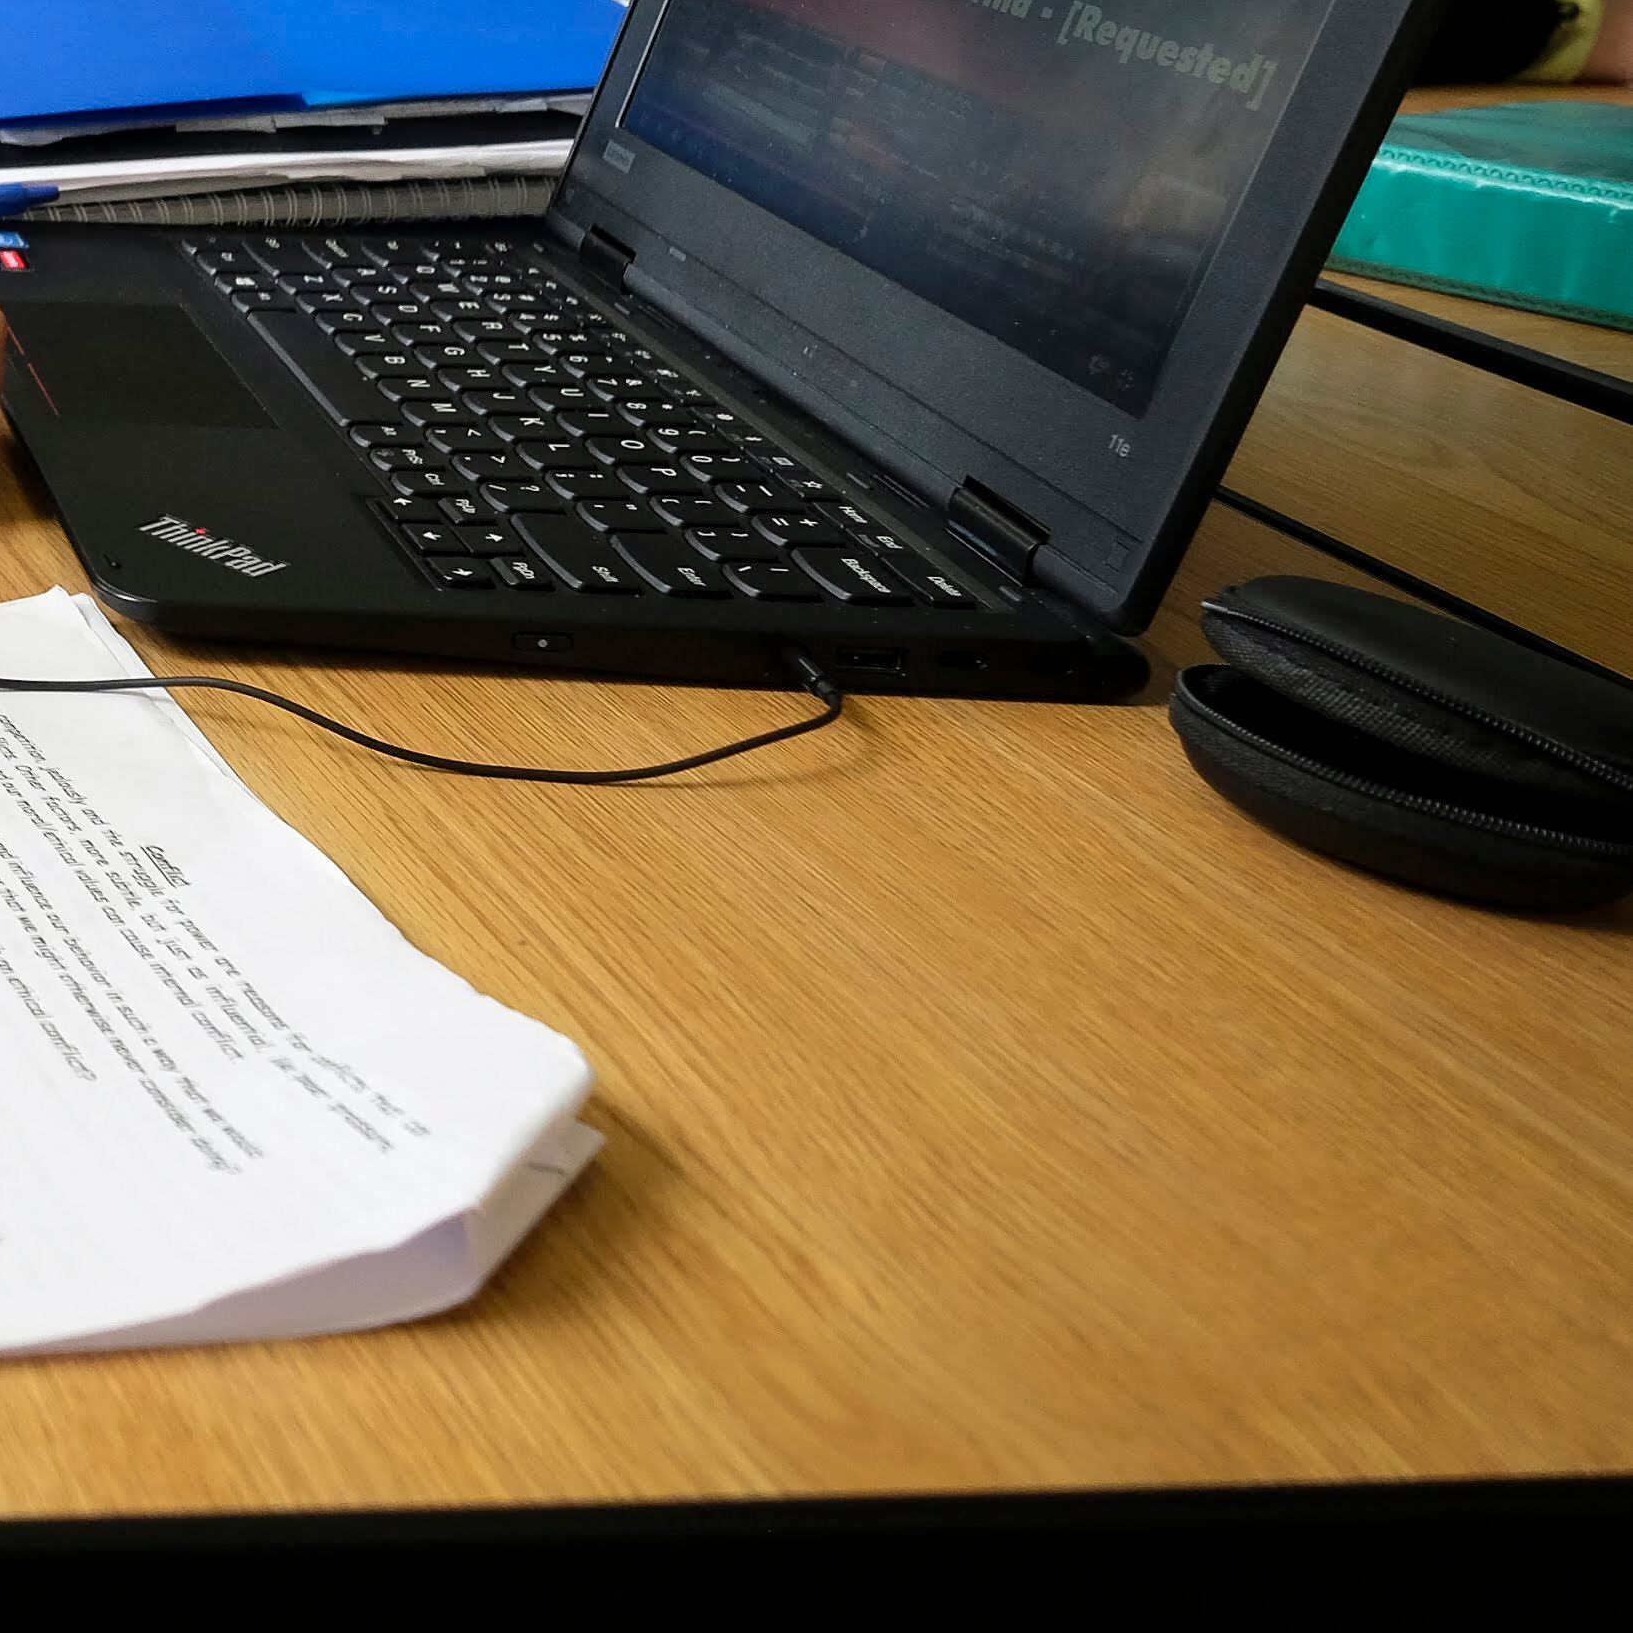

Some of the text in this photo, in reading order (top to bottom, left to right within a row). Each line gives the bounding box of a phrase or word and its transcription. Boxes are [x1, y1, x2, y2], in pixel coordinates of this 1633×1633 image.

[1056, 0, 1277, 112] [Requested]
[467, 369, 490, 378] H
[534, 365, 556, 375] Y
[560, 388, 584, 397] U
[519, 417, 545, 426] K
[1108, 434, 1131, 457] 11e
[651, 467, 677, 477] P
[138, 514, 288, 577] ThinkPad
[841, 558, 891, 594] Backspace
[15, 765, 47, 792] Other
[43, 768, 87, 806] jealously
[81, 808, 110, 826] and
[101, 829, 124, 848] the
[119, 851, 165, 897] struggle
[145, 845, 190, 887] Conflict
